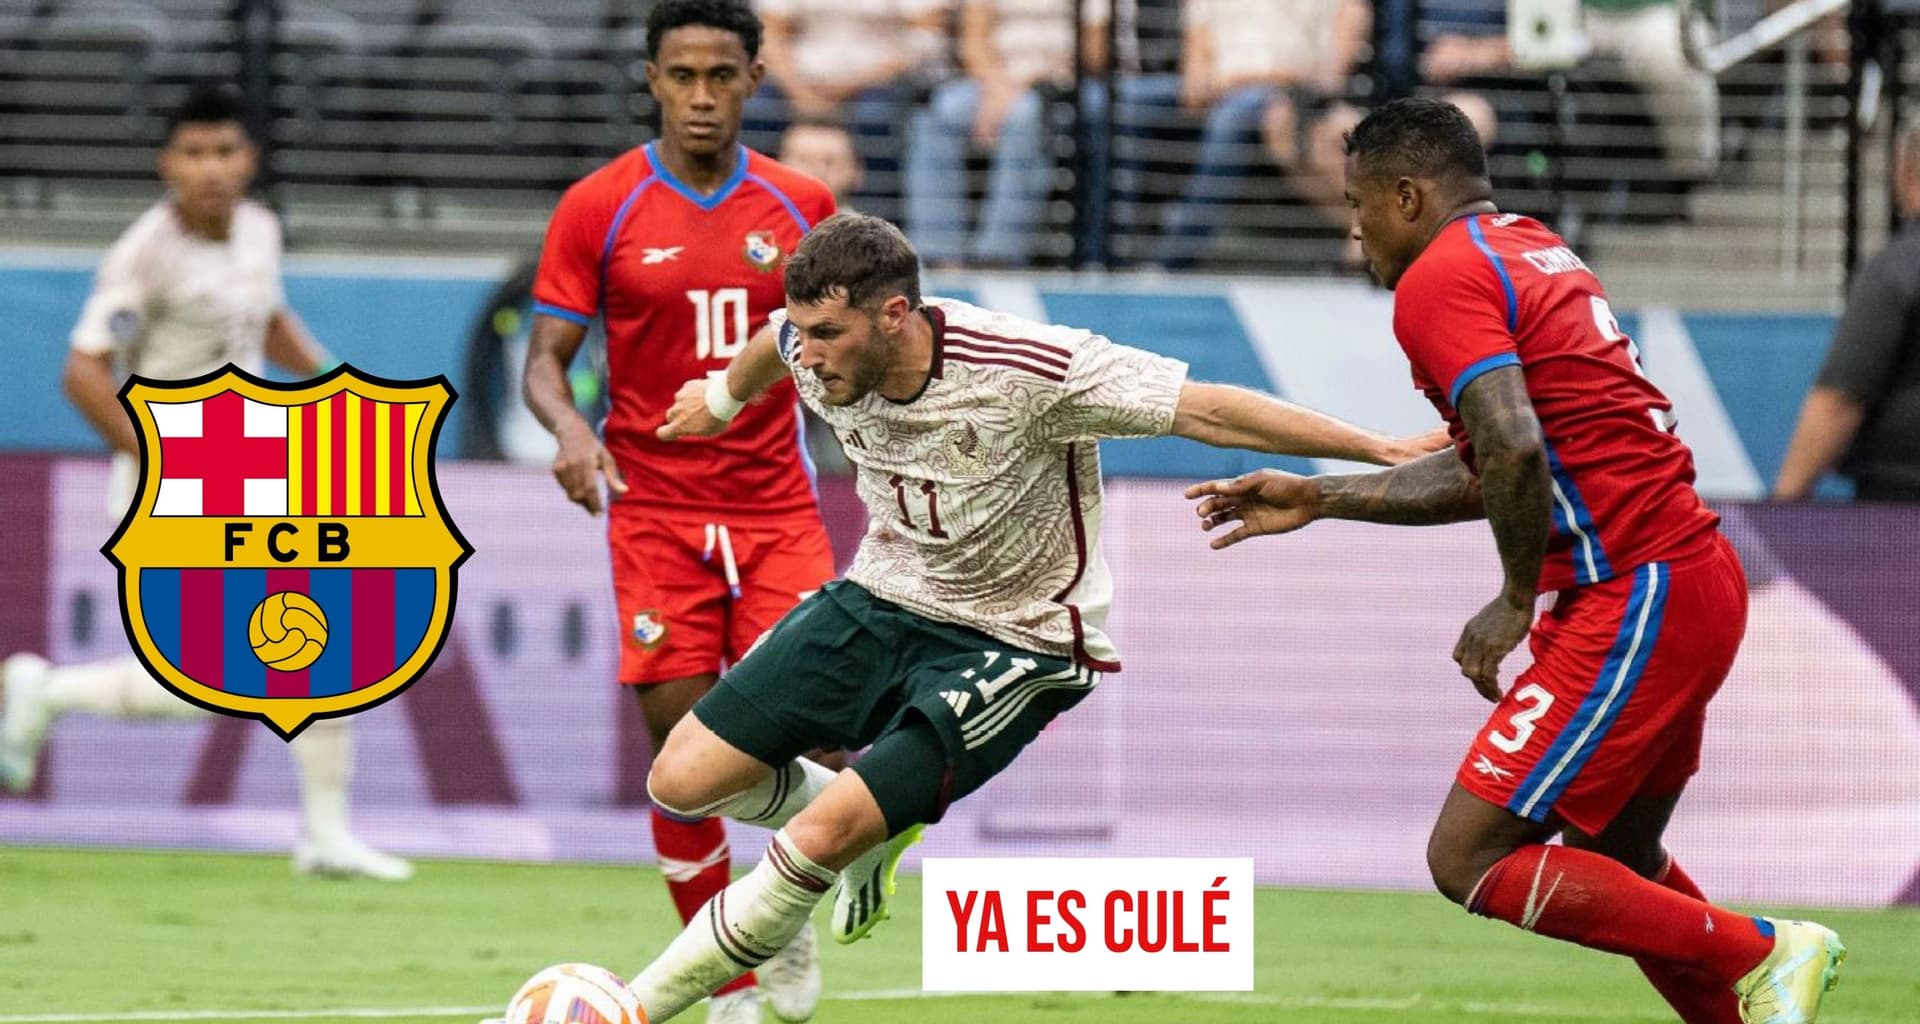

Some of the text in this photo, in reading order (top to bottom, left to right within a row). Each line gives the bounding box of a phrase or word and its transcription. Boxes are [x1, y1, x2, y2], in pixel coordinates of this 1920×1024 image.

[686, 288, 748, 360] 10
[889, 474, 949, 539] 11
[1488, 683, 1555, 754] 3
